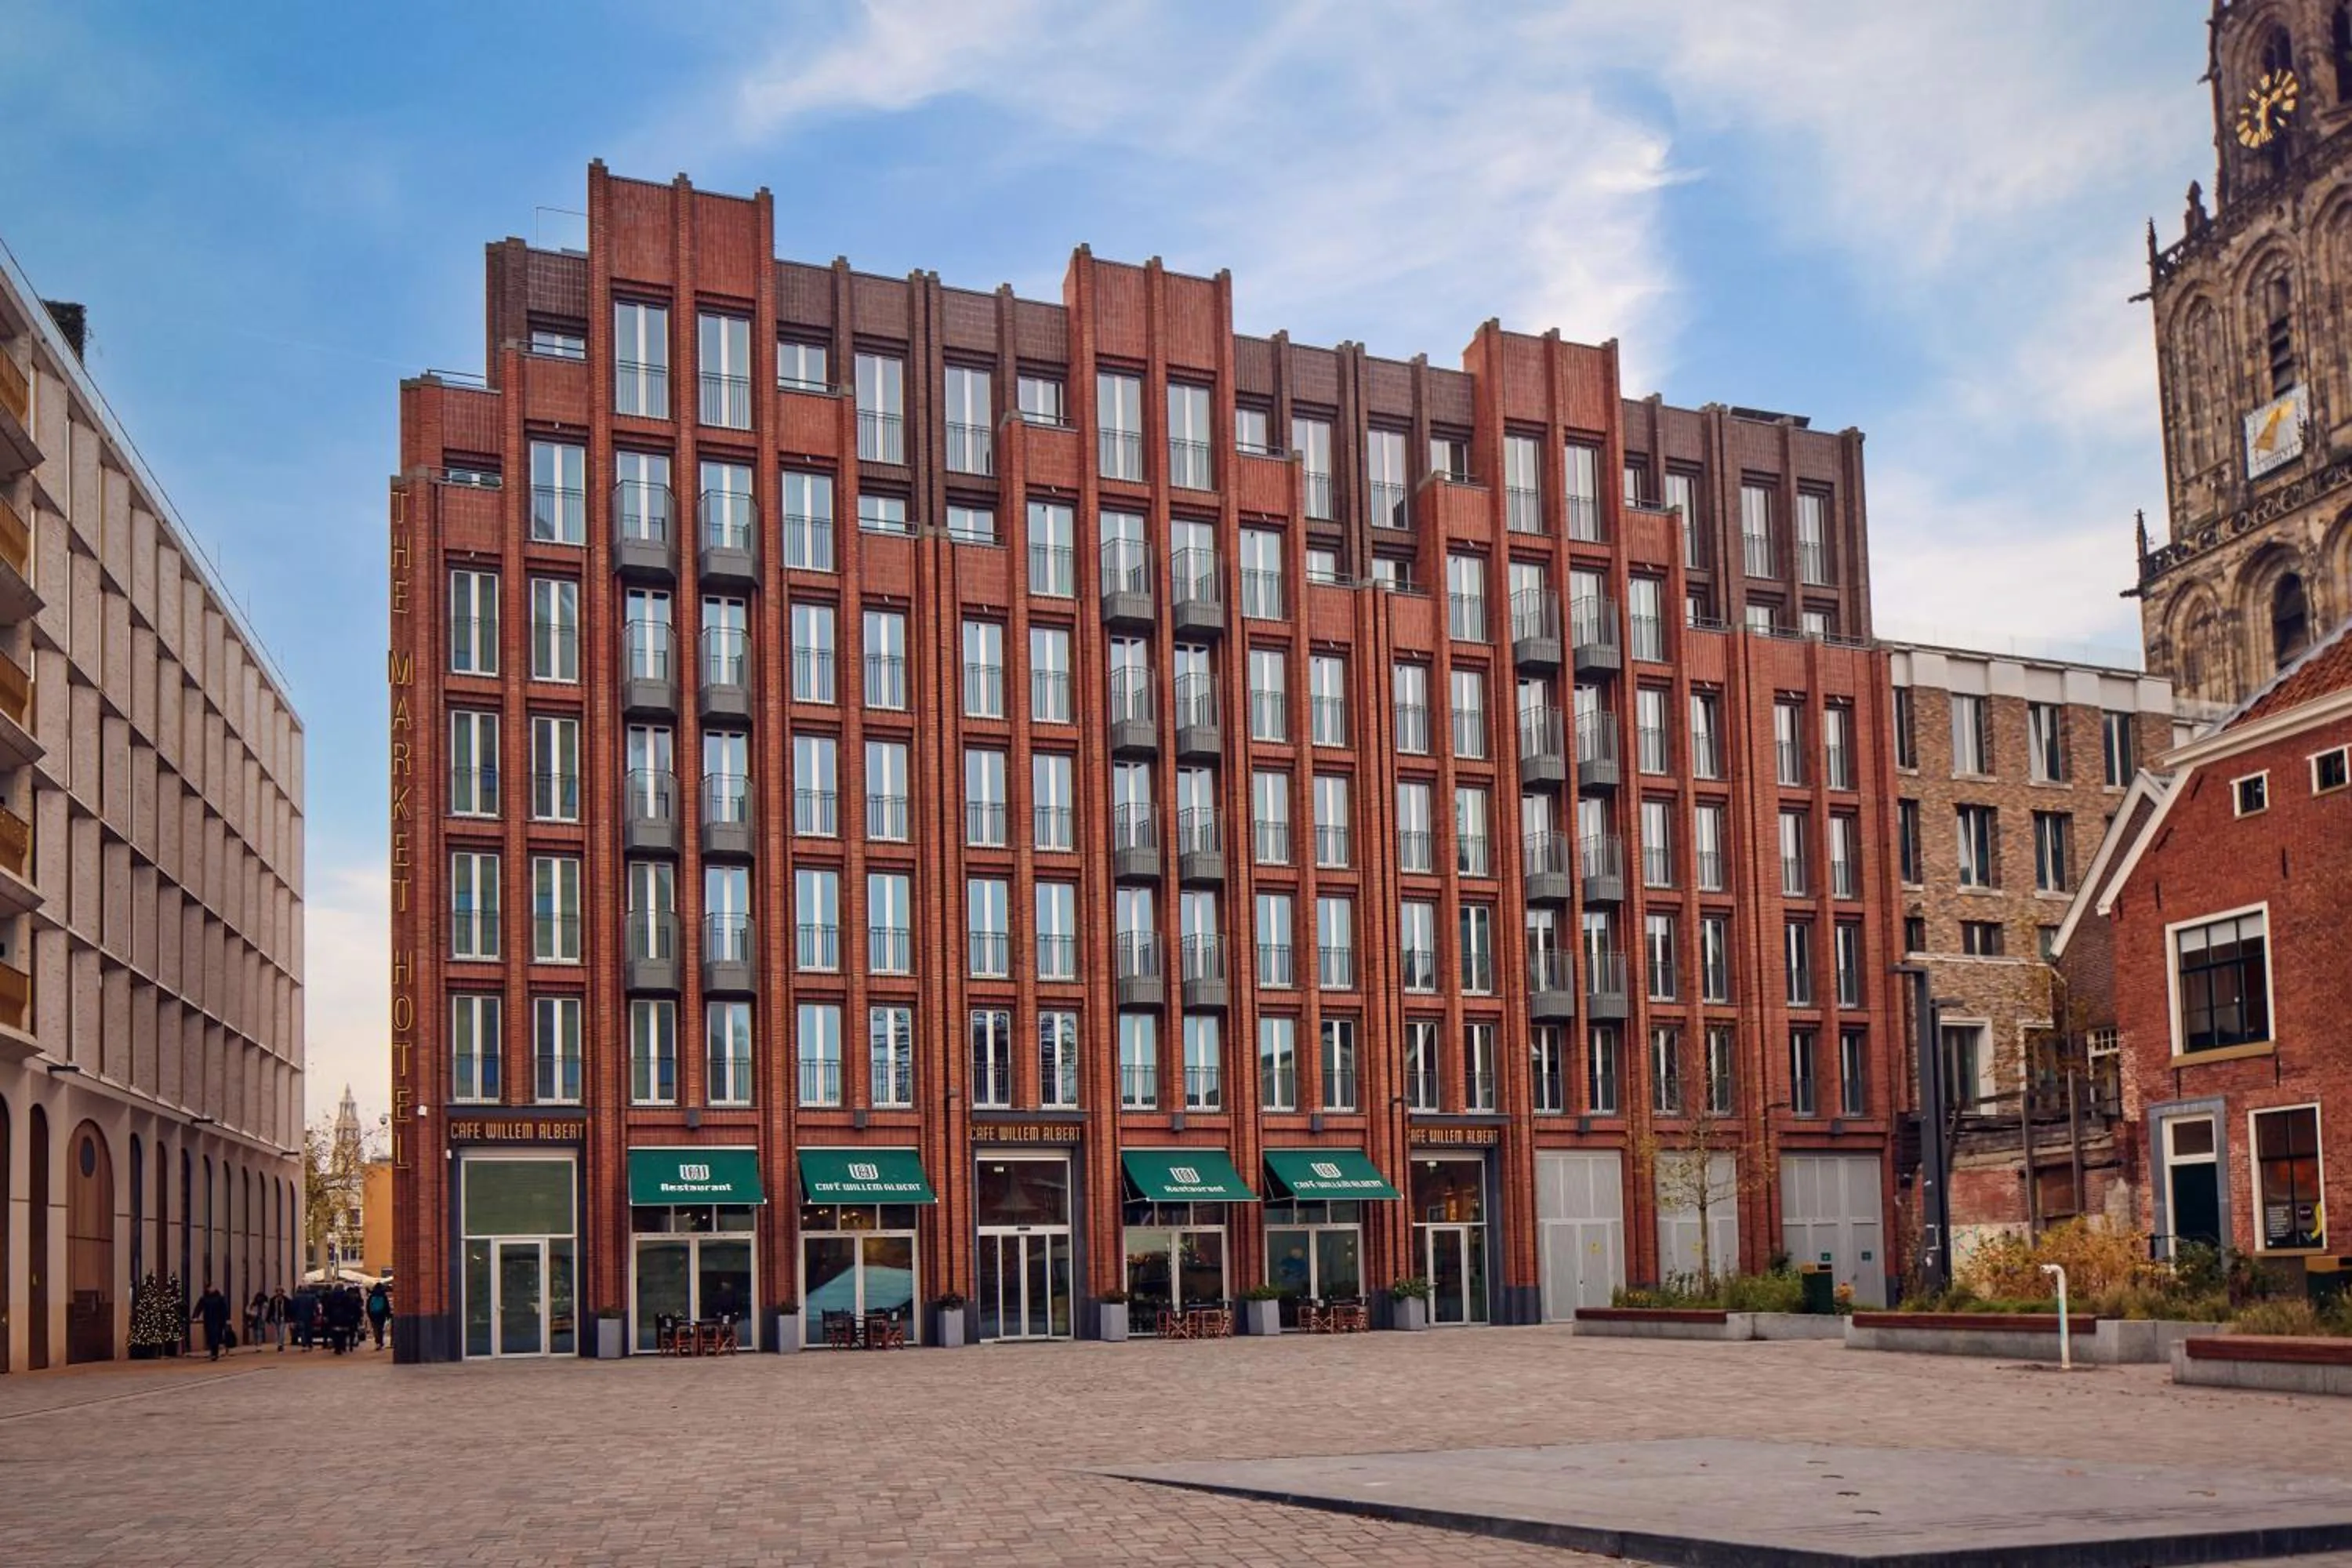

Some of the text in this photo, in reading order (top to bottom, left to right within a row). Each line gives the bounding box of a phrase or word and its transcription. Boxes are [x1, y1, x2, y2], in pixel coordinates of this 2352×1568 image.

[389, 491, 413, 1169] THE MARKET HOTEL
[450, 1122, 583, 1139] CAFE WILLEM ALBERT
[970, 1126, 1080, 1141] CAFE WILLEM ALBERT
[1429, 1130, 1465, 1144] WILLEM
[1466, 1130, 1498, 1144] ALBERT
[660, 1182, 733, 1192] Restaurant
